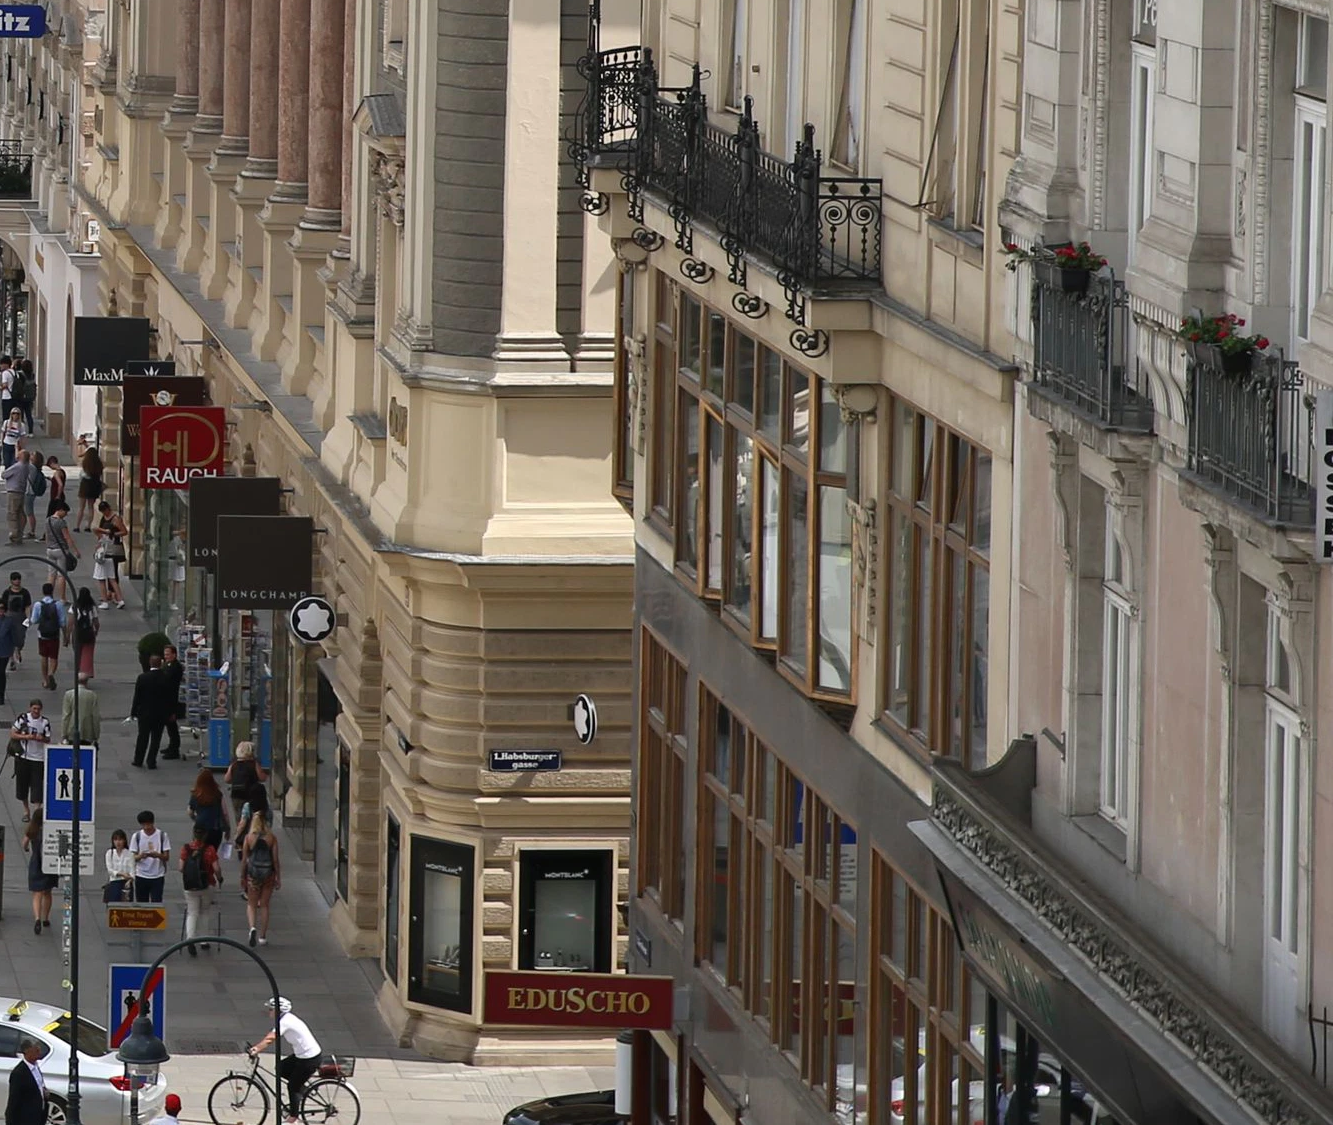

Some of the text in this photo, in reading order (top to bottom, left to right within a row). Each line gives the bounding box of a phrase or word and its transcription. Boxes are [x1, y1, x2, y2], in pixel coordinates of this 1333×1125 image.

[83, 367, 126, 382] MaxM
[223, 589, 307, 600] LONGCHAMP
[512, 762, 539, 770] gasse
[507, 986, 651, 1015] EDUSCHO
